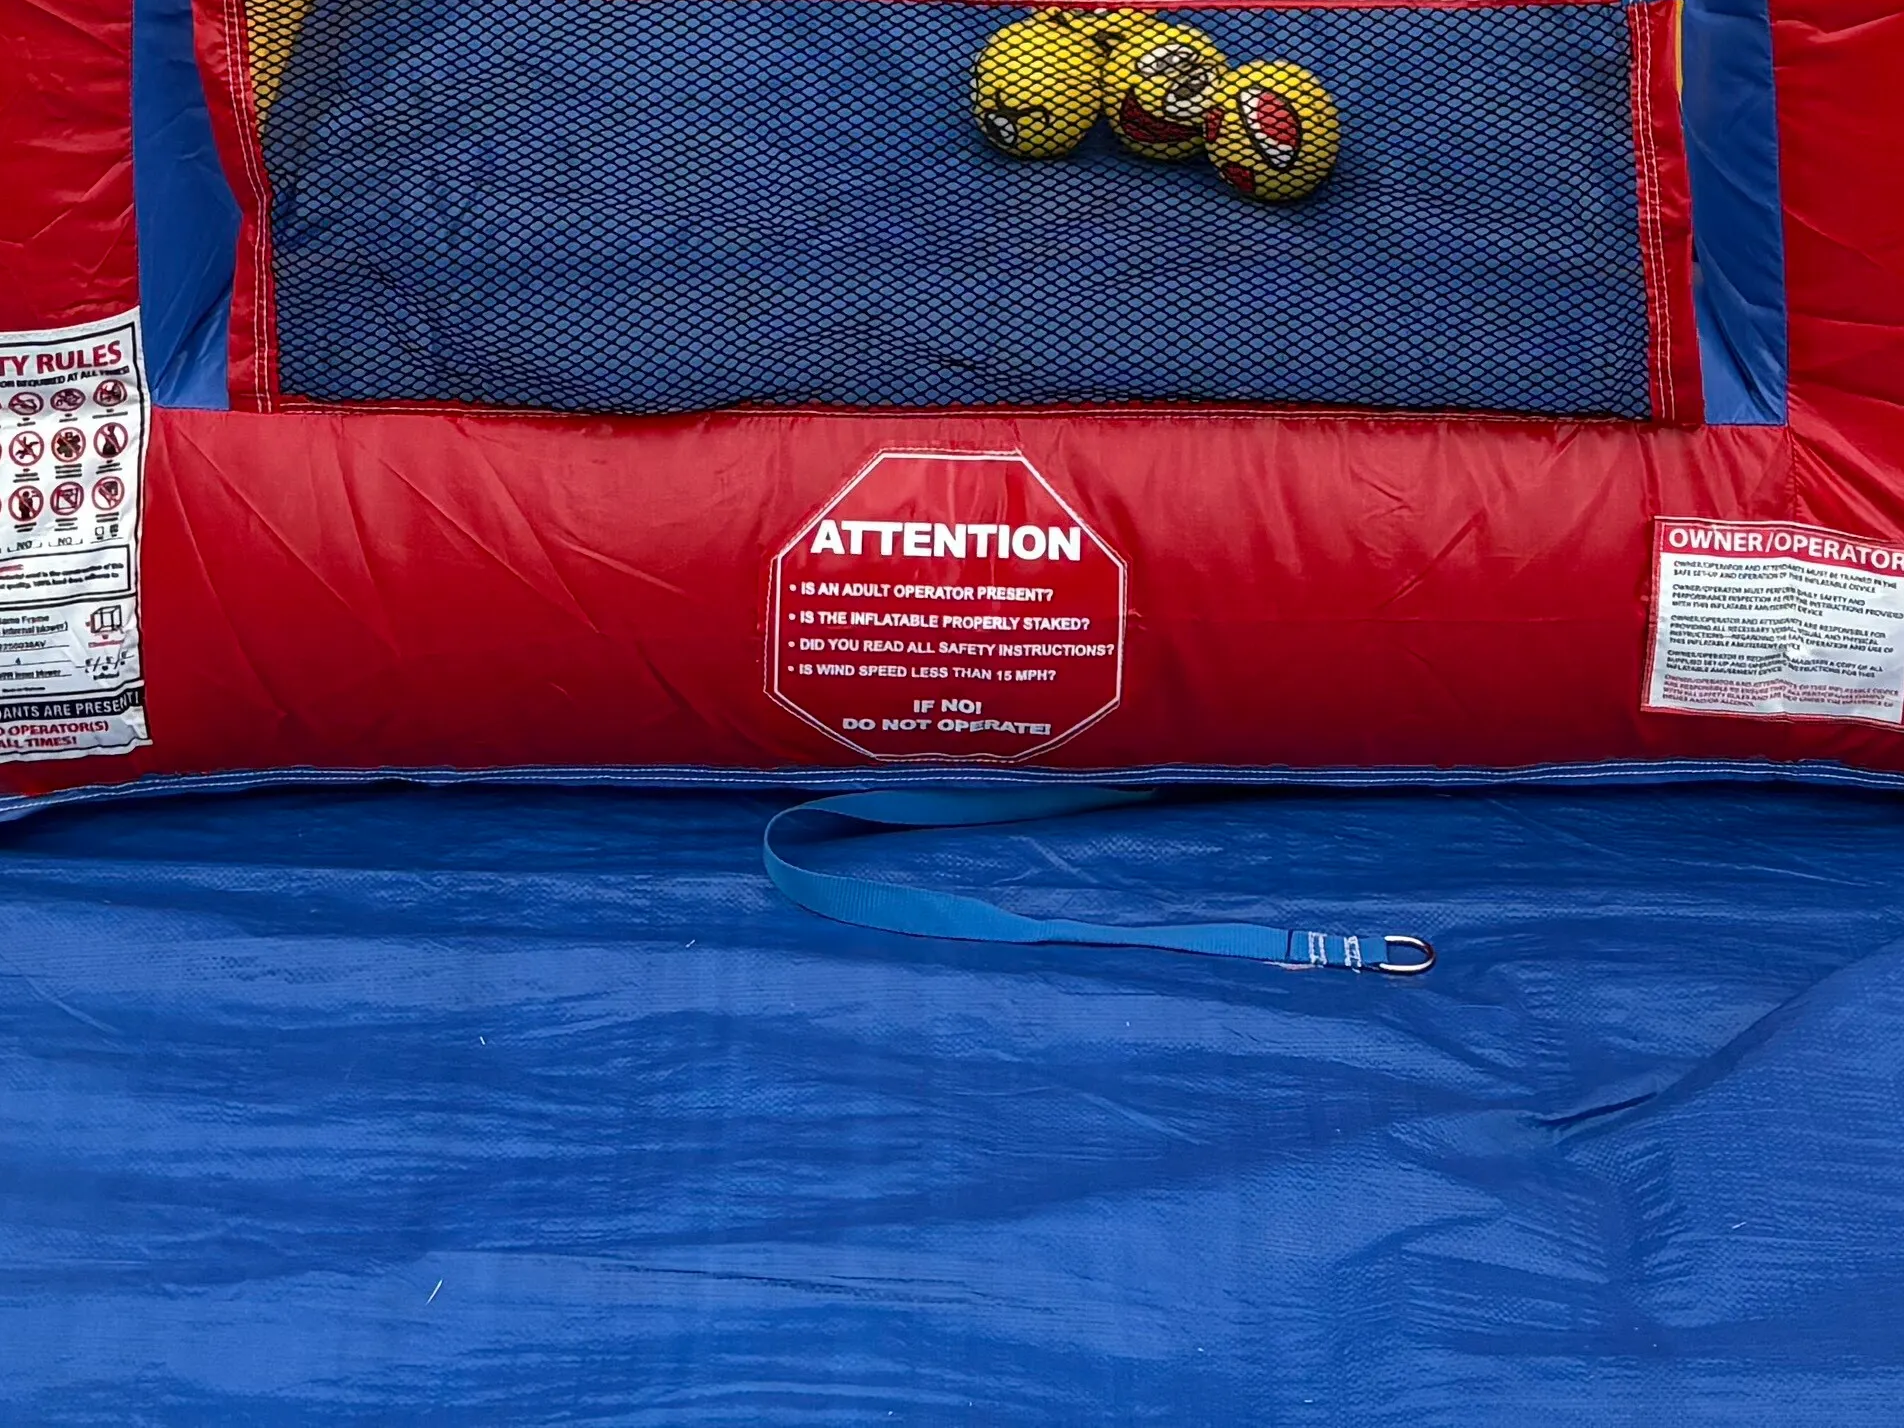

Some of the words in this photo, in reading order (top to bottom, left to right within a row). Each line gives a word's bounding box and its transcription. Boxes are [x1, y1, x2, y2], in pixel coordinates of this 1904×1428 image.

[36, 340, 122, 374] RULES
[810, 519, 1081, 561] ATTENTION
[801, 581, 815, 595] IS
[818, 582, 839, 596] AN
[842, 583, 891, 597] ADULT
[894, 584, 974, 600] OPERATOR
[977, 586, 1054, 602] PRESENT?
[800, 610, 815, 624] IS
[818, 611, 847, 625] THE
[851, 612, 939, 628] INFLATABLE
[942, 615, 1021, 630] PROPERLY
[1023, 617, 1090, 631] STAKED?
[800, 638, 825, 651] DID
[827, 638, 859, 651] YOU
[863, 640, 904, 652] READ
[907, 642, 935, 654] ALL
[938, 642, 996, 656] SAFETY
[999, 644, 1115, 657] INSTRUCTIONS?
[799, 663, 813, 675] IS
[816, 664, 855, 676] WIND
[858, 665, 907, 678] SPEED
[911, 666, 948, 678] LESS
[952, 667, 992, 680] THAN
[997, 670, 1012, 681] 15
[1015, 669, 1056, 682] MPH?
[44, 703, 71, 717] ARE
[76, 691, 139, 715] PRESENT!
[913, 699, 935, 713] IF
[941, 699, 982, 714] NO!
[8, 720, 109, 736] OPERATOR(S)
[842, 718, 876, 730] DO
[882, 719, 932, 730] NOT
[937, 719, 1051, 735] OPERATE!
[27, 735, 77, 748] TIMES!
